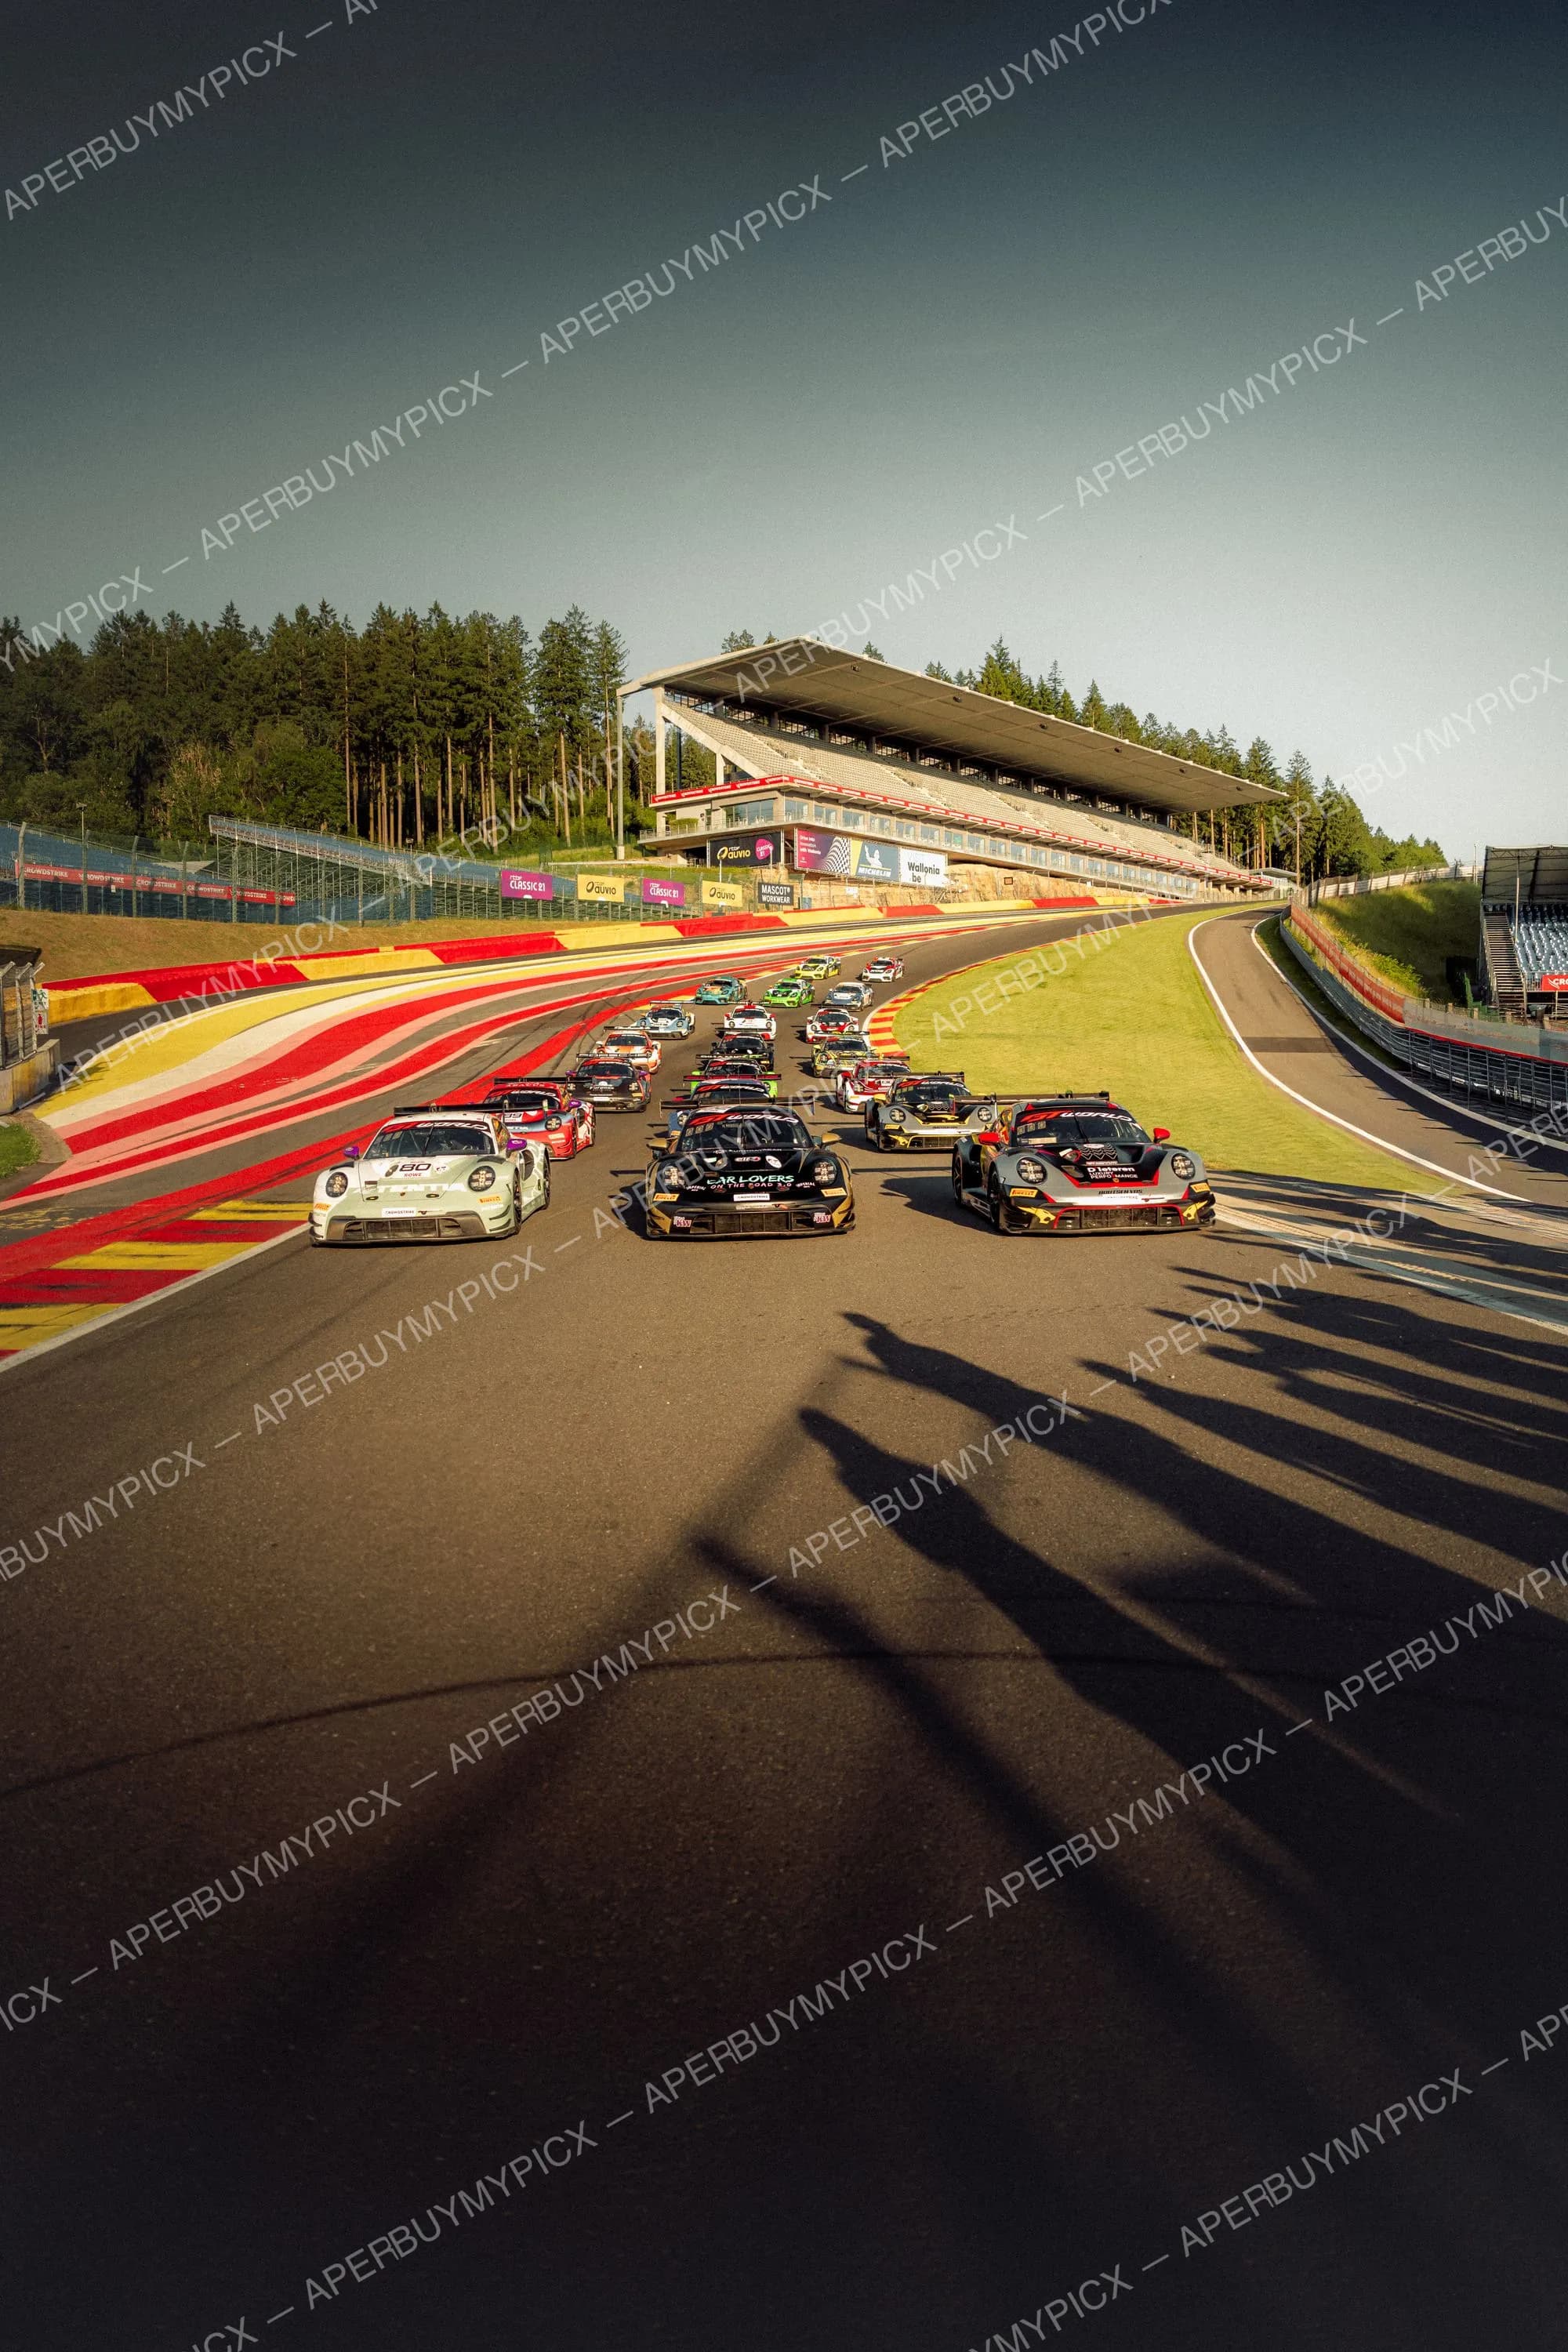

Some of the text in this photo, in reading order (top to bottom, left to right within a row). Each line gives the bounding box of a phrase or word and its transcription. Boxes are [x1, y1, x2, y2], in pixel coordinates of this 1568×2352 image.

[858, 867, 891, 878] MICHELIN
[908, 862, 940, 875] Wallonia
[912, 873, 921, 884] be
[187, 884, 225, 894] CRWDSTRIKE
[510, 880, 546, 892] CLASSIC 21
[594, 886, 616, 895] auvio
[650, 887, 672, 897] CLASSIC
[717, 891, 735, 900] auvio
[761, 895, 790, 904] WORKWEAR
[399, 1163, 431, 1172] 80
